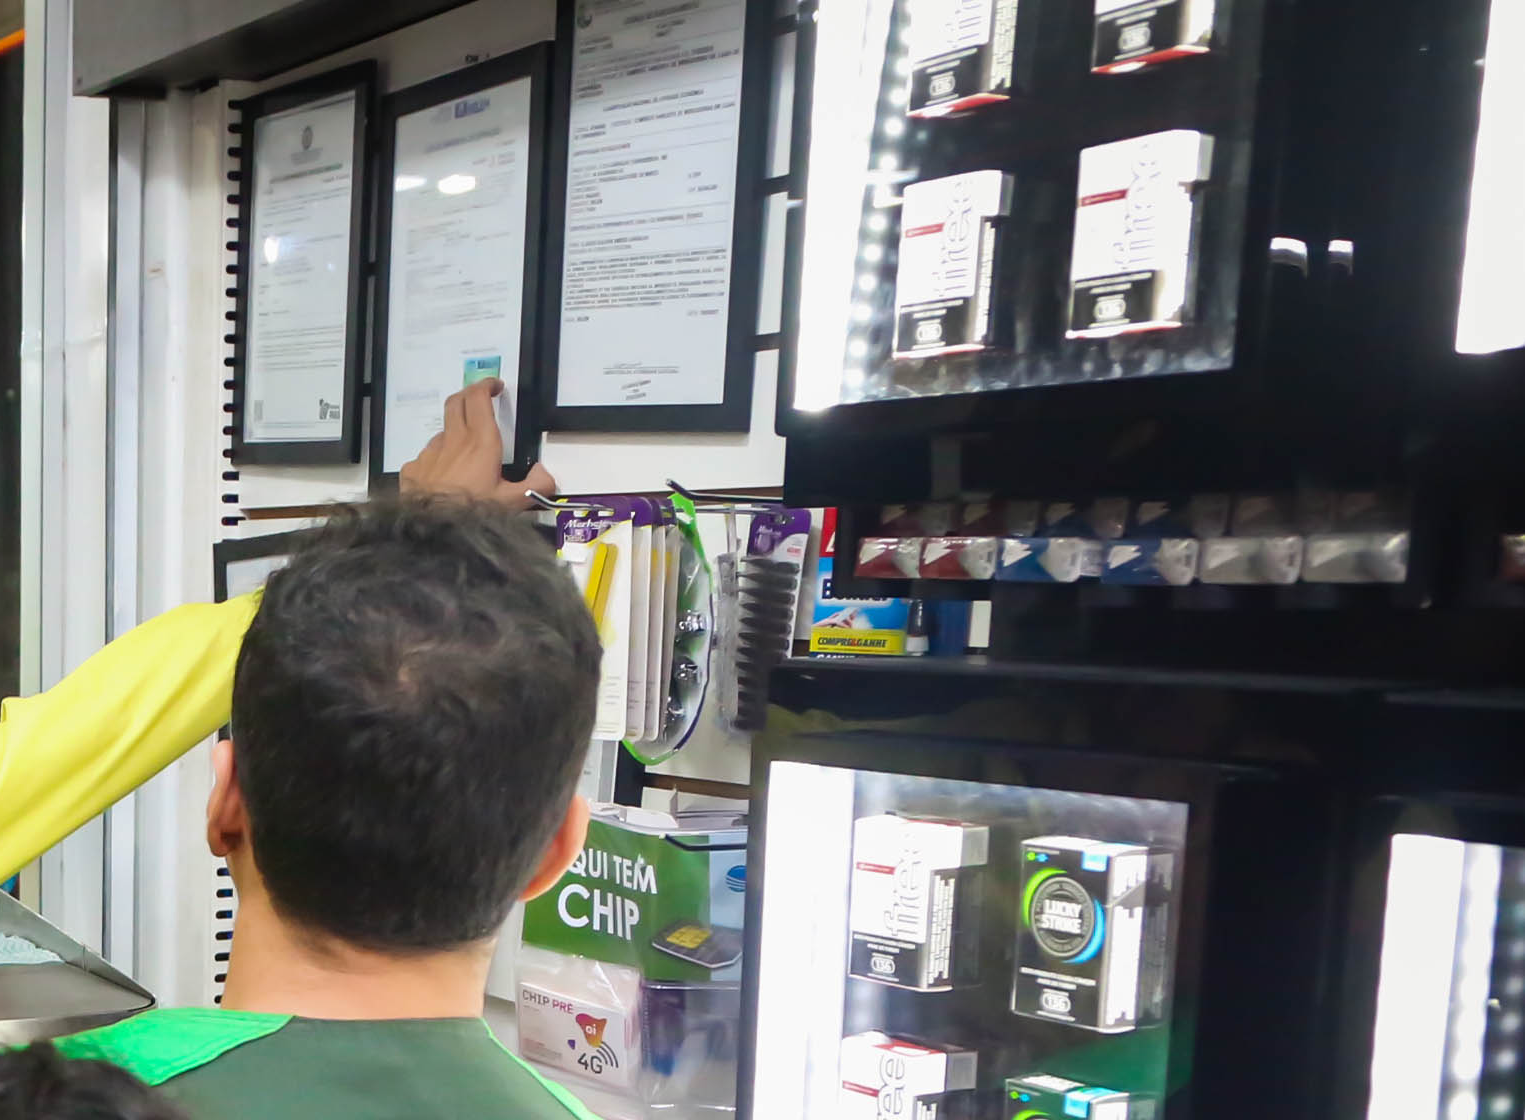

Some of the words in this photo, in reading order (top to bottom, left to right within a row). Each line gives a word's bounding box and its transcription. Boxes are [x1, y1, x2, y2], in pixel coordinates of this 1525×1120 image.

[568, 848, 608, 880] QUI
[613, 854, 658, 894] TEM
[557, 883, 640, 941] CHIP
[1043, 899, 1082, 918] LUCKY
[1035, 914, 1082, 934] STRIKE
[522, 989, 550, 1006] CHIP
[585, 1024, 597, 1035] oi
[577, 1052, 604, 1075] 4G
